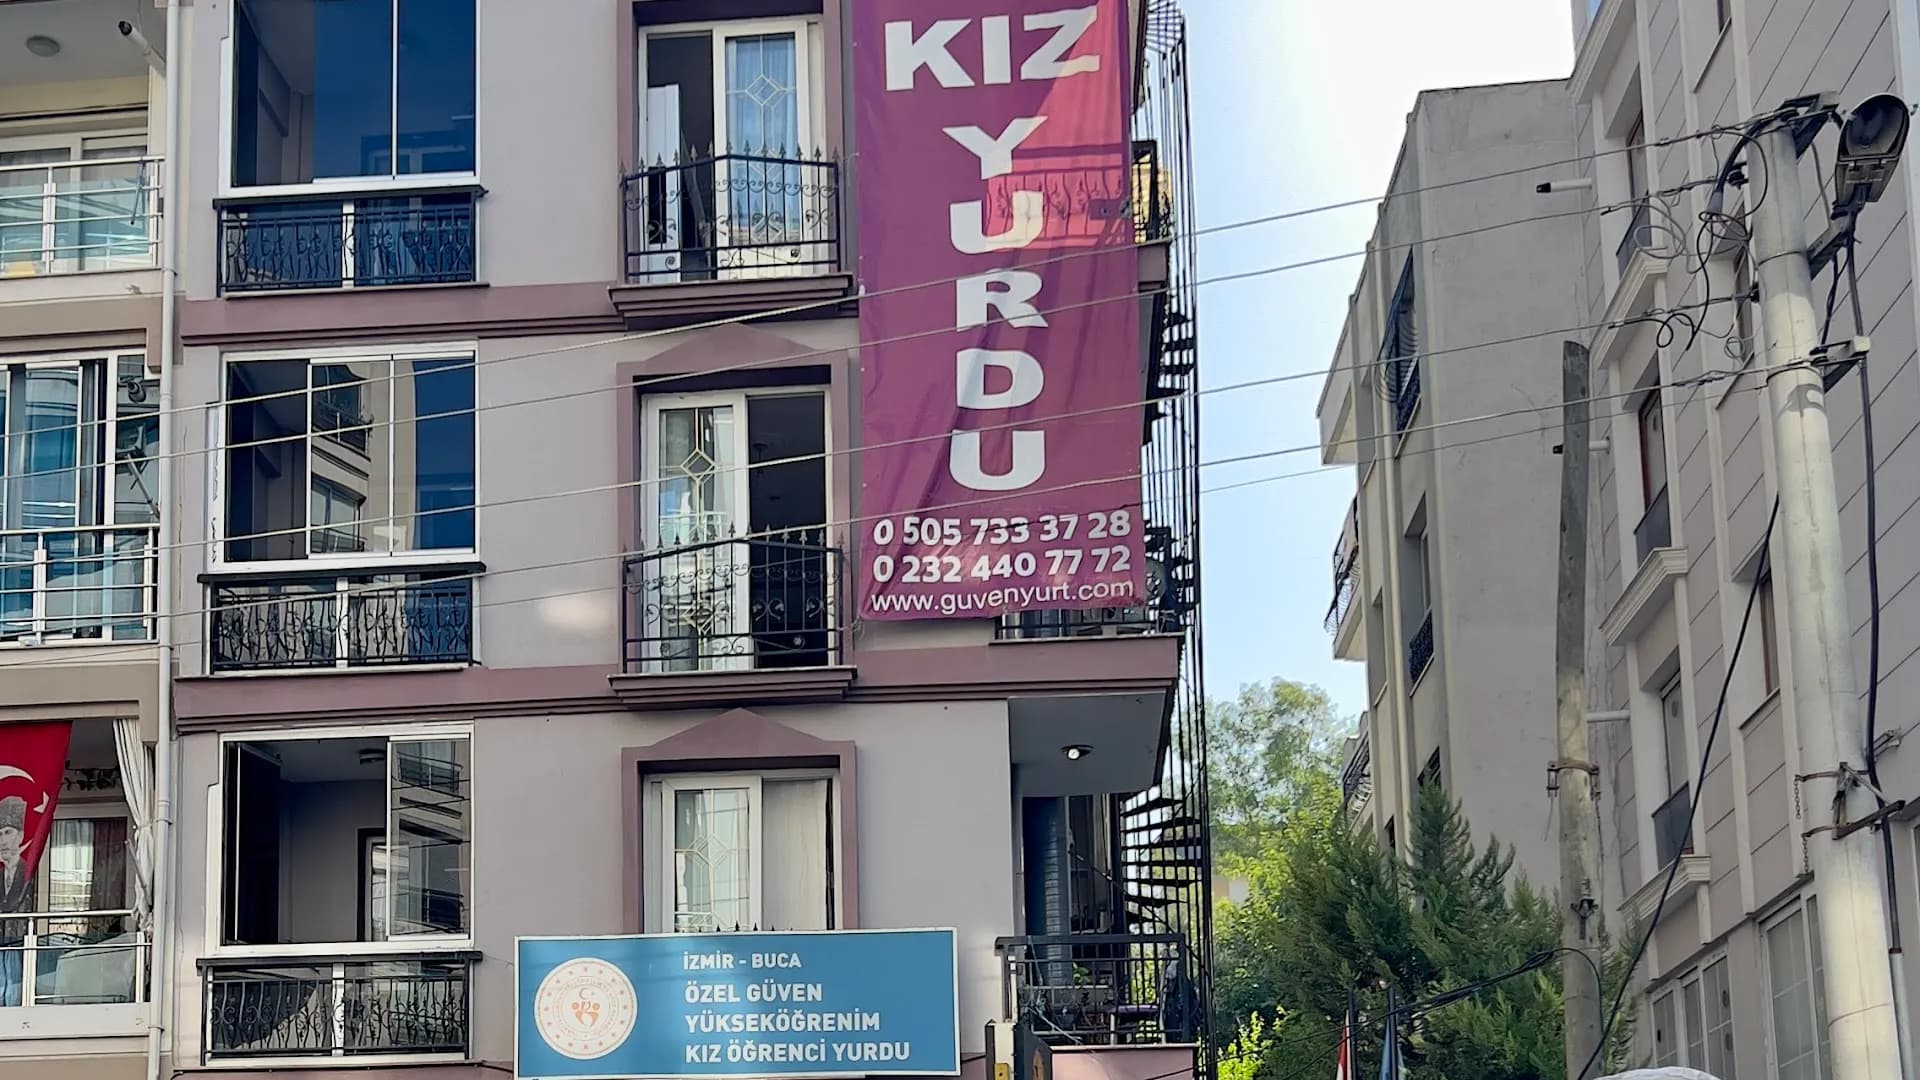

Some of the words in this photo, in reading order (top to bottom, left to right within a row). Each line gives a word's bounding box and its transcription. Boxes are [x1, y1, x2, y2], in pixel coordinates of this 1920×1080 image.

[885, 5, 1101, 91] KIZ
[873, 519, 894, 546] 0
[903, 516, 961, 546] 505
[970, 517, 1030, 546] 733
[1040, 514, 1079, 542] 37
[1088, 510, 1131, 539] 28
[873, 555, 895, 583] 0
[902, 555, 961, 583] 232
[971, 552, 1036, 581] 440
[1045, 549, 1082, 576] 77
[1091, 545, 1131, 573] 72
[871, 580, 1134, 614] www.guvenyurt.com
[683, 950, 734, 970] İZMİR
[751, 953, 802, 969] BUCA
[685, 980, 741, 1003] ÖZEL
[746, 978, 823, 1002] GÜVEN
[685, 1008, 880, 1033] YÜKSEKÖĞRENİM
[685, 1043, 721, 1063] KIZ
[727, 1038, 826, 1063] ÖĞRENCİ
[832, 1041, 911, 1062] YURDU
